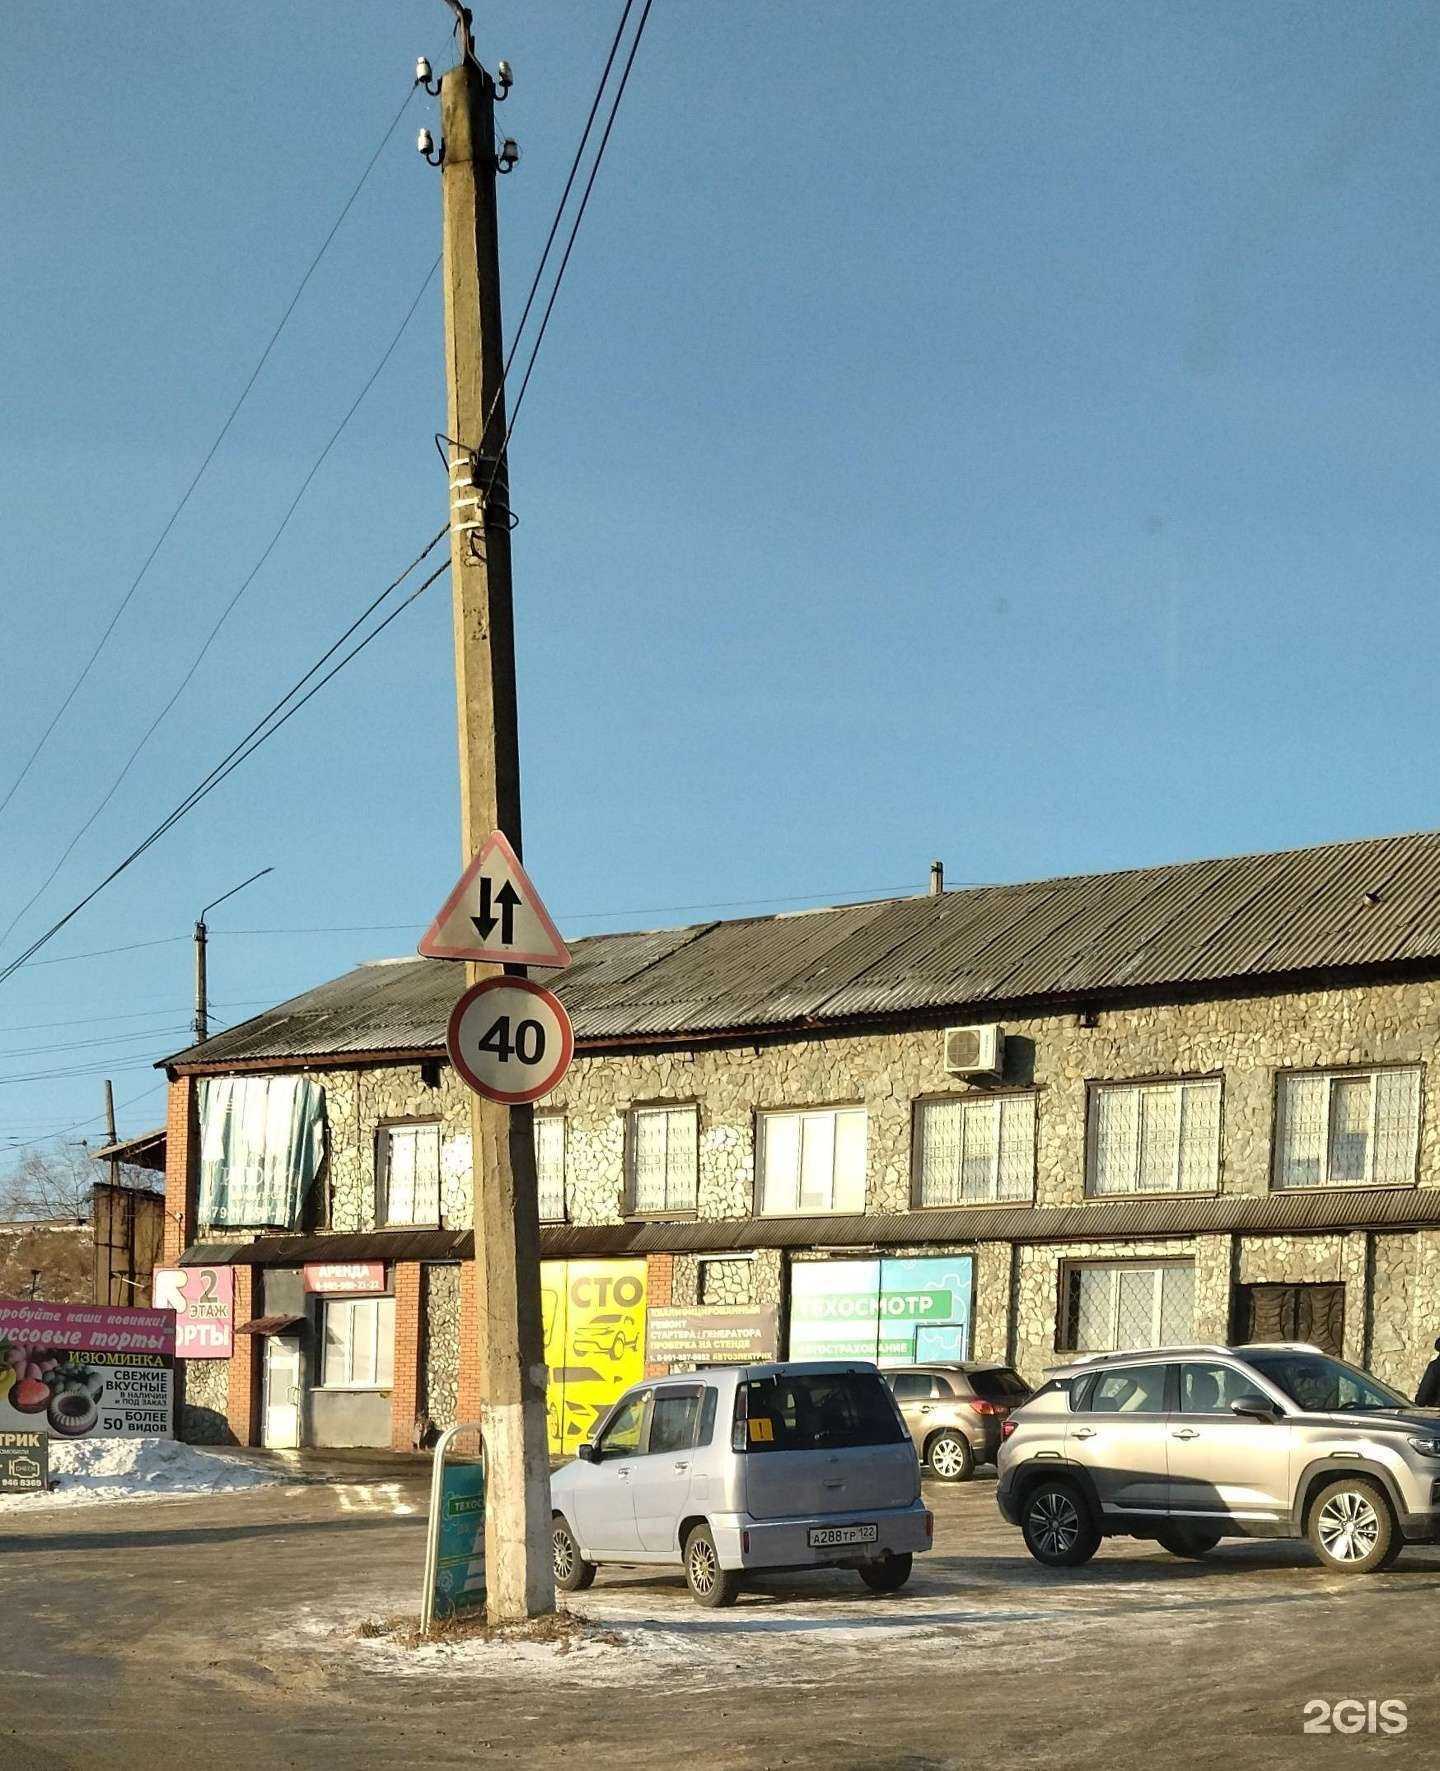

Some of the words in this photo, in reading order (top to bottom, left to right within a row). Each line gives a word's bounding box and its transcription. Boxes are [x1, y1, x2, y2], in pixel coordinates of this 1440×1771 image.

[478, 1016, 546, 1065] 40
[200, 1269, 218, 1304] 2
[571, 1275, 644, 1308] СТО
[66, 1311, 102, 1324] наши
[107, 1314, 167, 1328] новинки!
[190, 1304, 228, 1318] ЭТАЖ
[89, 1331, 165, 1351] торты
[68, 1350, 164, 1367] ИЗЮМИНКА
[114, 1370, 168, 1382] СВЕЖИЕ
[105, 1380, 168, 1393] ВКУСНЫЕ
[103, 1417, 123, 1431] 50
[125, 1411, 168, 1423] БОЛЕЕ
[813, 1530, 856, 1544] А288ТР
[859, 1526, 874, 1537] 122
